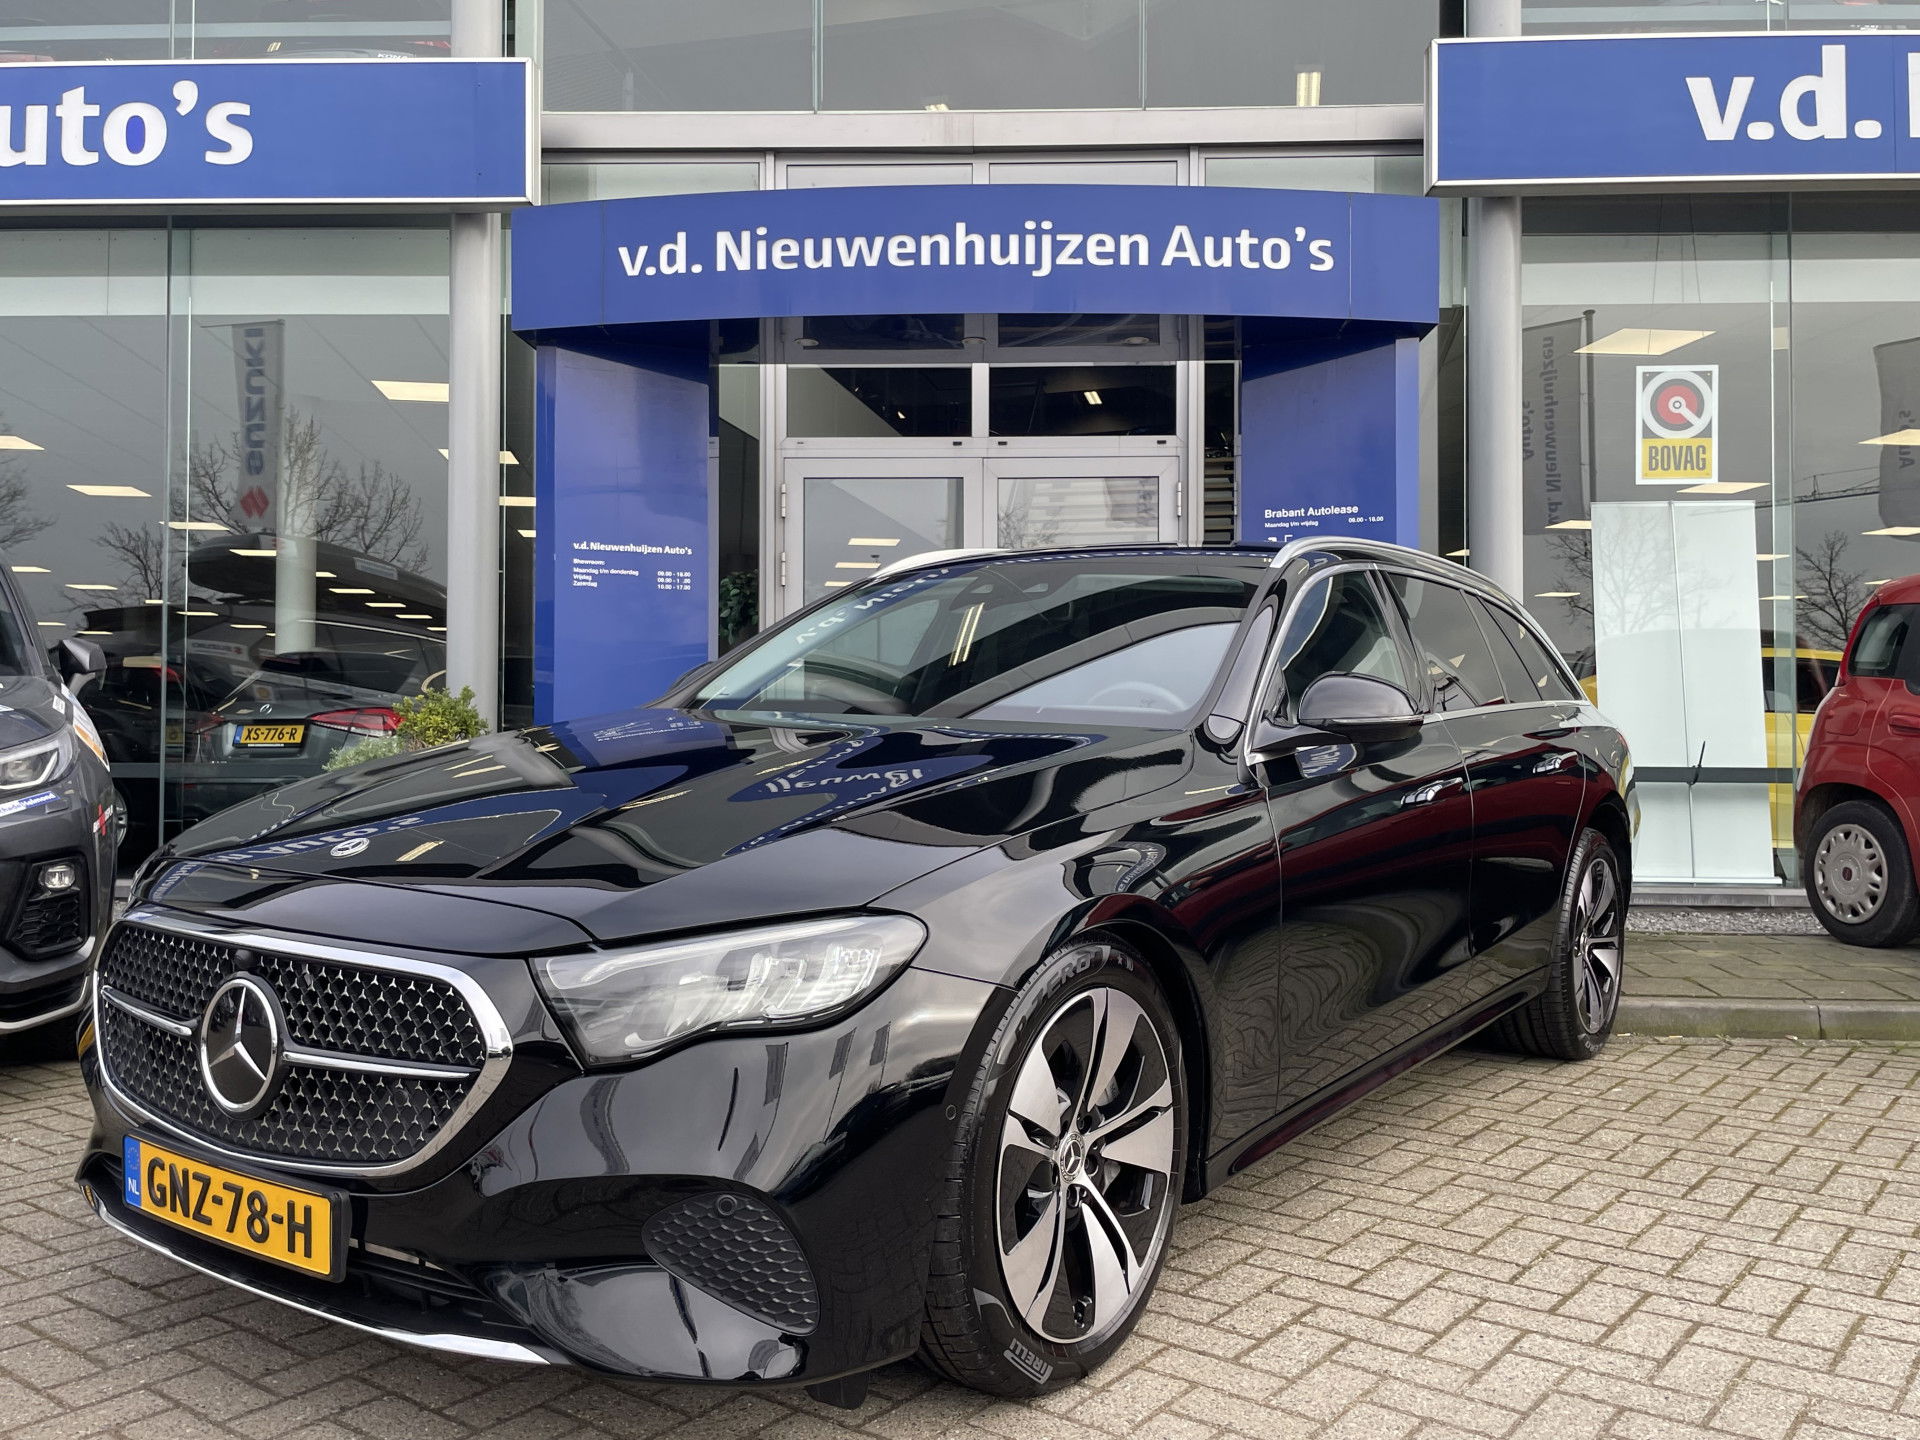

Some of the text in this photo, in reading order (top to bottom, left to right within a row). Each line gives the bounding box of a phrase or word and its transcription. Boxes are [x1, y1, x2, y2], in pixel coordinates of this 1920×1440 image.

[1686, 44, 1883, 141] v.d.
[0, 80, 254, 167] uto's
[618, 220, 1335, 278] v.d. Nieuwenhuijzen Auto's
[1648, 445, 1707, 472] BOVAG
[1264, 505, 1359, 519] Brabant Autolease
[573, 541, 693, 555] v.d. Nieuwenhuijzen Auto's
[573, 566, 599, 575] Maandag
[610, 569, 639, 577] donderdag
[244, 725, 298, 742] XS-776-R
[1031, 952, 1091, 1011] ZERO
[128, 1176, 140, 1196] NL
[147, 1156, 313, 1259] GNZ-78-H
[1003, 1337, 1054, 1385] PIRELLI
